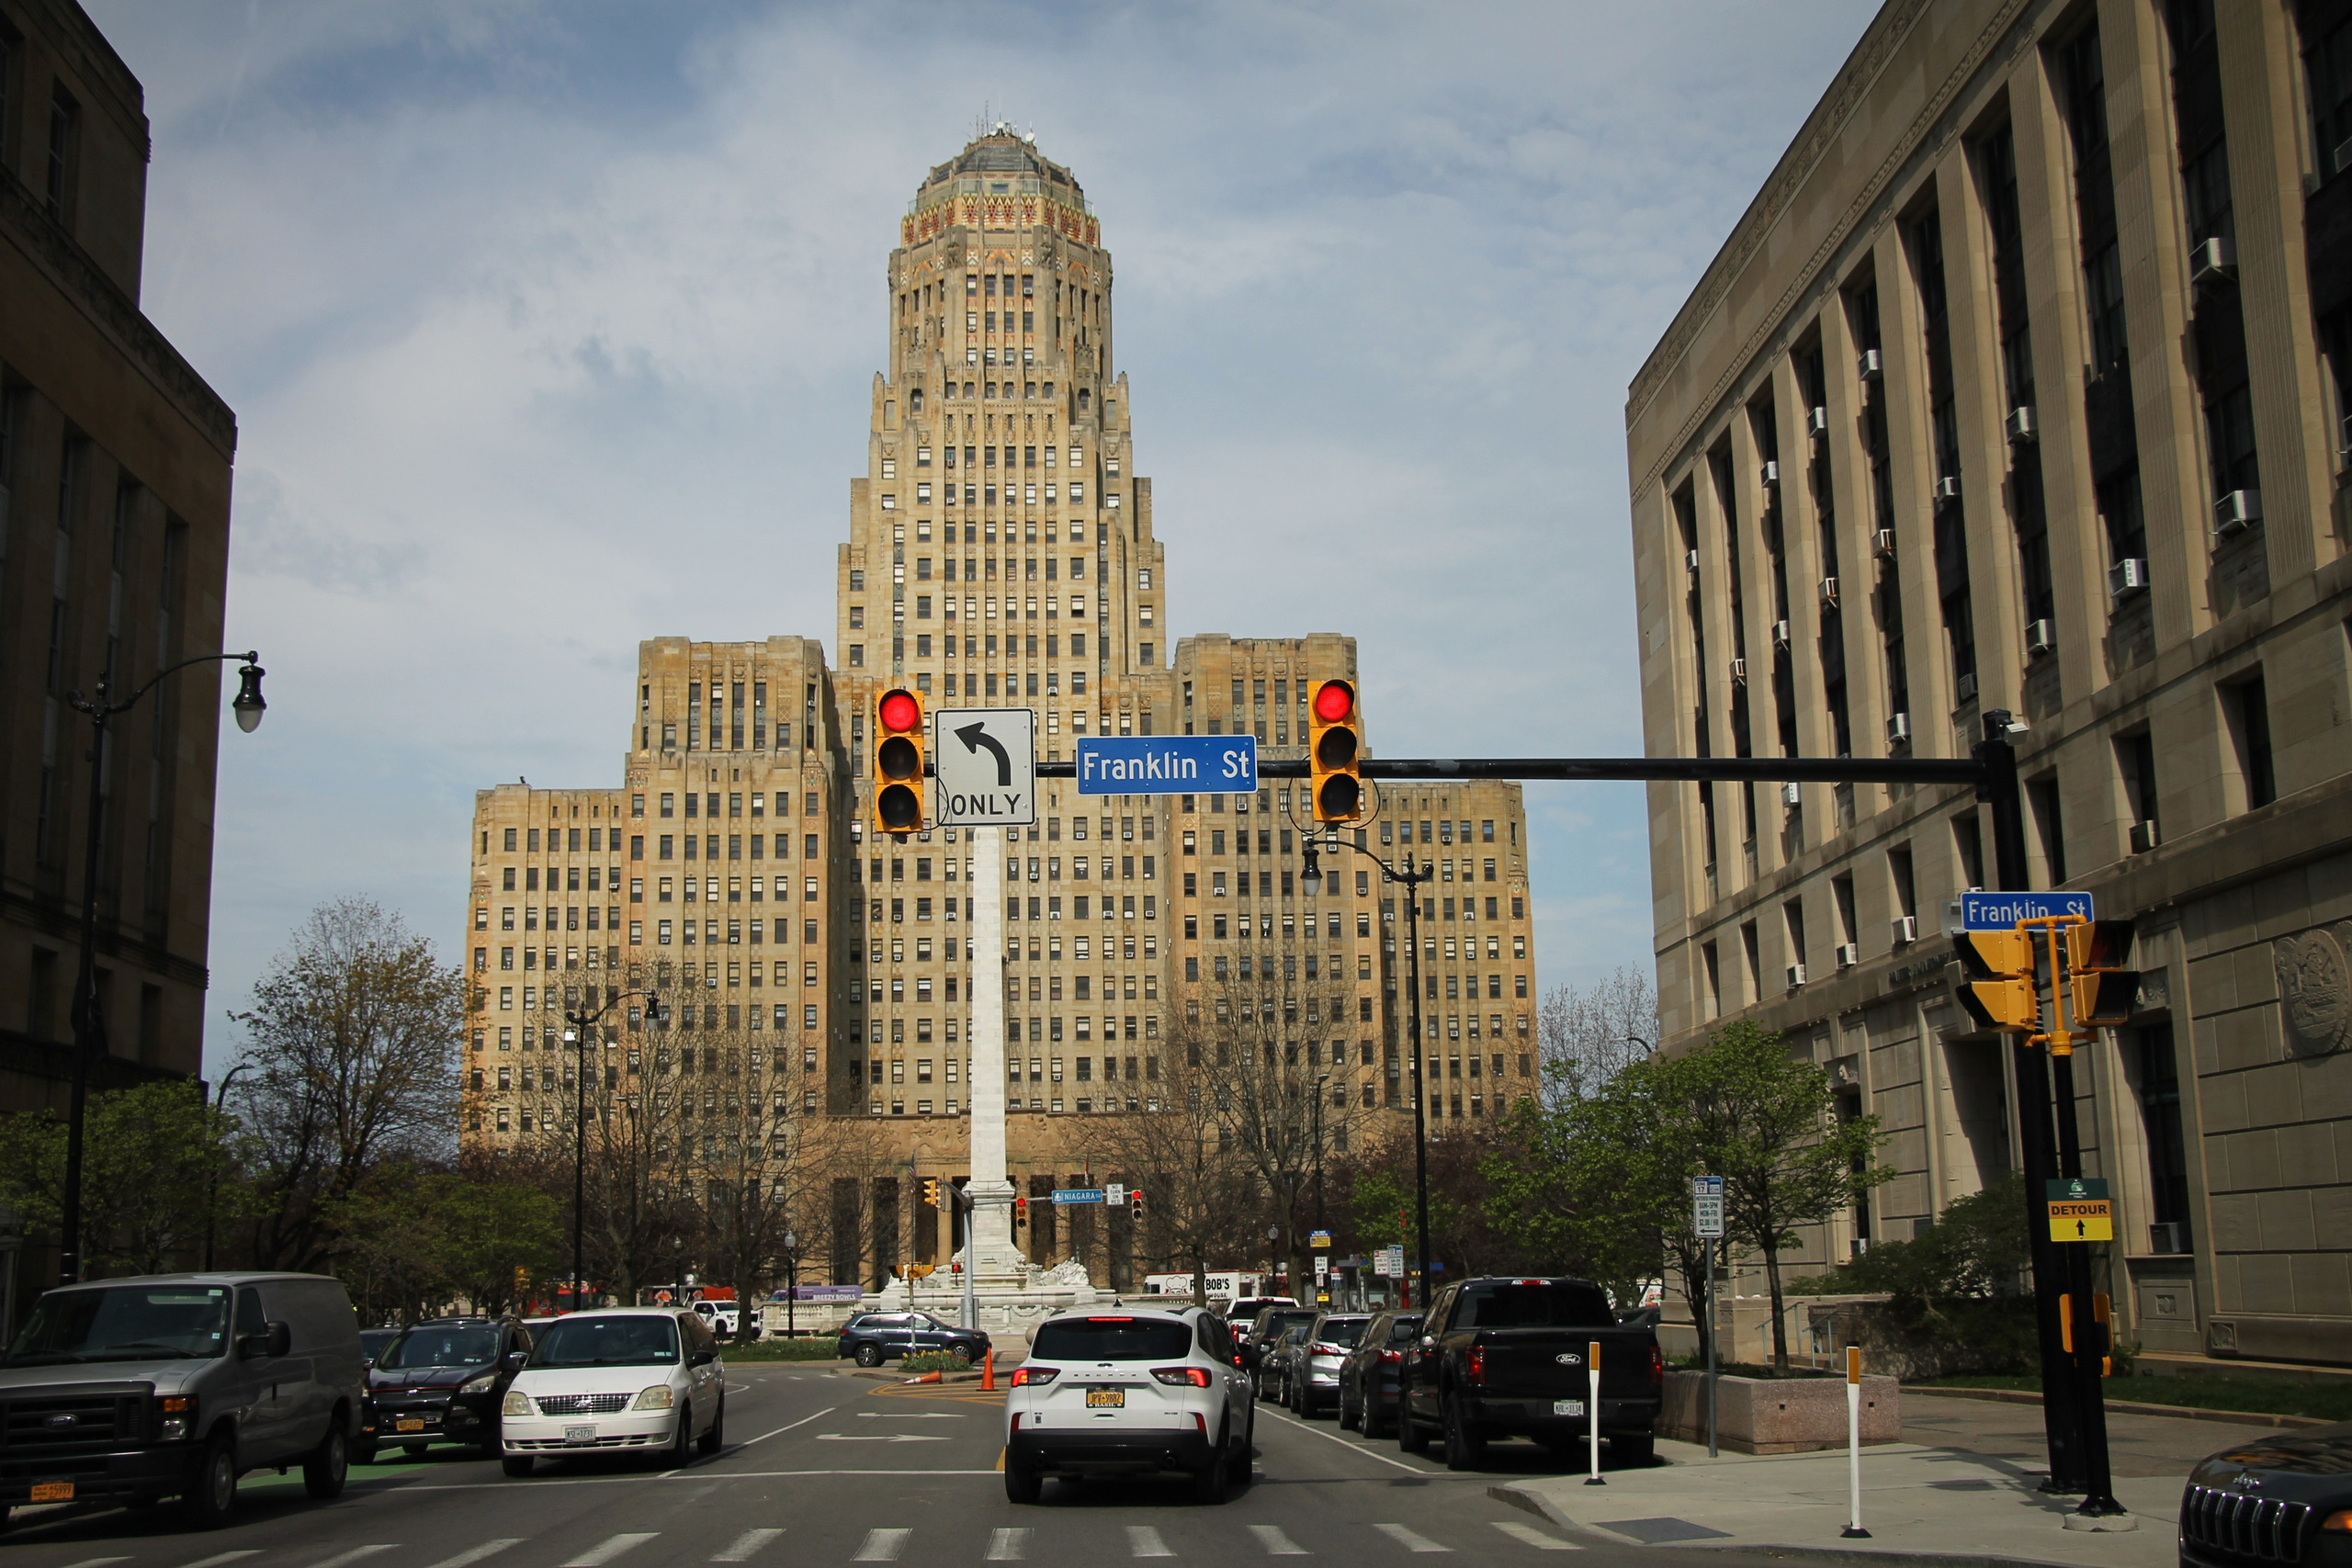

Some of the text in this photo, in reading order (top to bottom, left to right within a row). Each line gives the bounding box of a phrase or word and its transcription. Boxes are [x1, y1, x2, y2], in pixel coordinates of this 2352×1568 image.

[1083, 750, 1250, 781] Franklin St
[951, 794, 1022, 816] ONLY
[1968, 899, 2086, 922] Franklin St
[1064, 1192, 1095, 1201] NIAGARA
[2051, 1204, 2108, 1215] DETOUR
[1205, 1278, 1230, 1291] BOB'S
